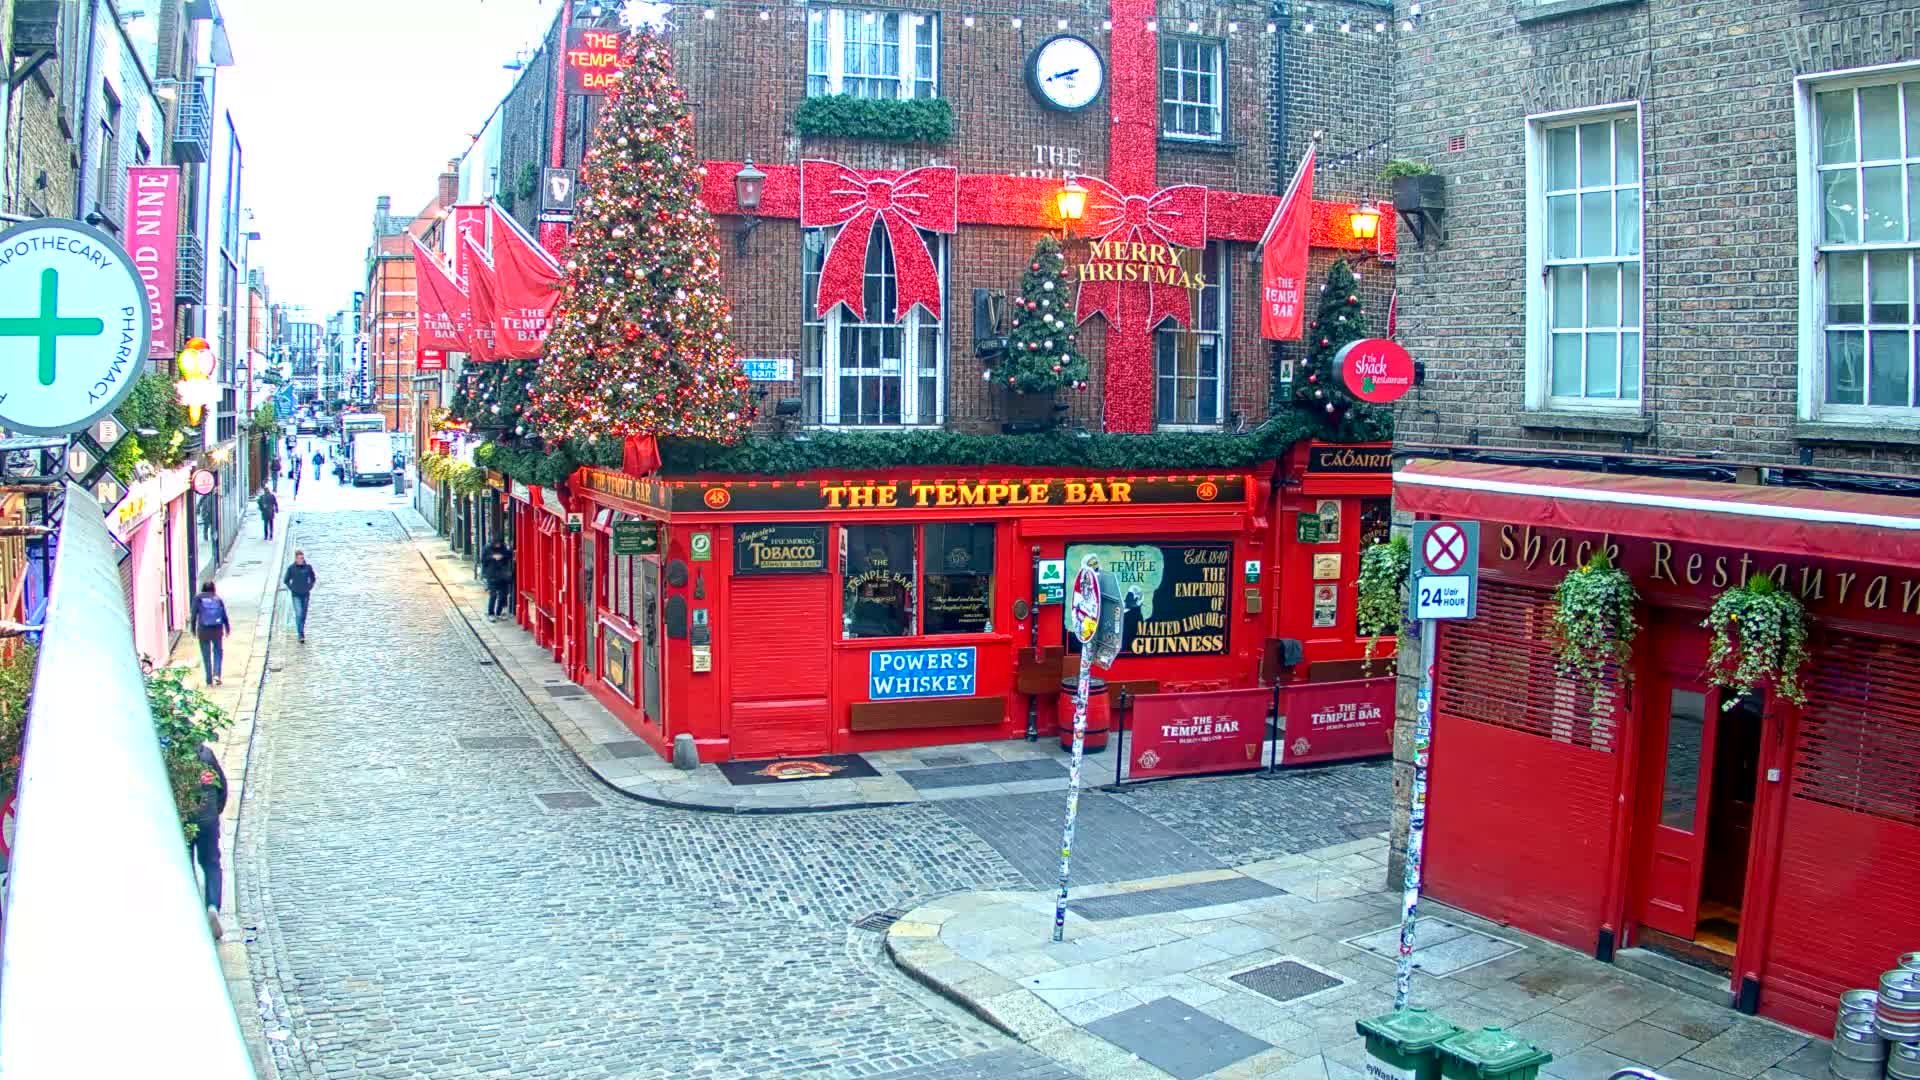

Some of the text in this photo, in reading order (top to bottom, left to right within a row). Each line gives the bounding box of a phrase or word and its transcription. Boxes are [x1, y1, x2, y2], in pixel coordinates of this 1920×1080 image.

[584, 33, 617, 49] THE
[568, 52, 621, 67] TEMPL
[1033, 145, 1080, 166] THE
[137, 175, 169, 236] NINE
[1089, 241, 1184, 266] MERRY
[1277, 277, 1293, 288] THE
[1265, 287, 1298, 303] TEMPL
[519, 308, 544, 318] THE
[1272, 304, 1293, 317] BAR
[501, 317, 552, 329] TEMPL
[518, 330, 547, 341] BAR
[88, 306, 136, 405] PHARMACY
[1355, 353, 1387, 378] Shack
[606, 474, 633, 498] TEMPLE
[635, 480, 651, 504] BAR
[823, 481, 1132, 508] THE TEMPLE BAR
[1199, 484, 1214, 497] 48
[708, 491, 726, 505] 48
[1500, 524, 1619, 569] Shack
[1120, 551, 1145, 561] THE
[1109, 560, 1156, 572] TEMPLE
[847, 569, 914, 591] TEMPLE BAR
[1121, 571, 1144, 583] BAR
[1202, 567, 1226, 582] THE
[1175, 583, 1225, 597] EMPEROR
[1421, 587, 1459, 607] 24 Uair
[1211, 597, 1224, 611] OF
[1443, 597, 1466, 607] HOUR
[1136, 612, 1226, 636] MALTED LIQUORS
[1131, 635, 1223, 654] GUINNESS
[879, 652, 968, 671] POWER'S
[873, 673, 973, 694] WHISKEY
[1338, 703, 1357, 712] THE
[1192, 715, 1212, 725] THE
[1311, 707, 1382, 725] TEMPLE BAR
[1161, 720, 1239, 737] TEMPLE BAR
